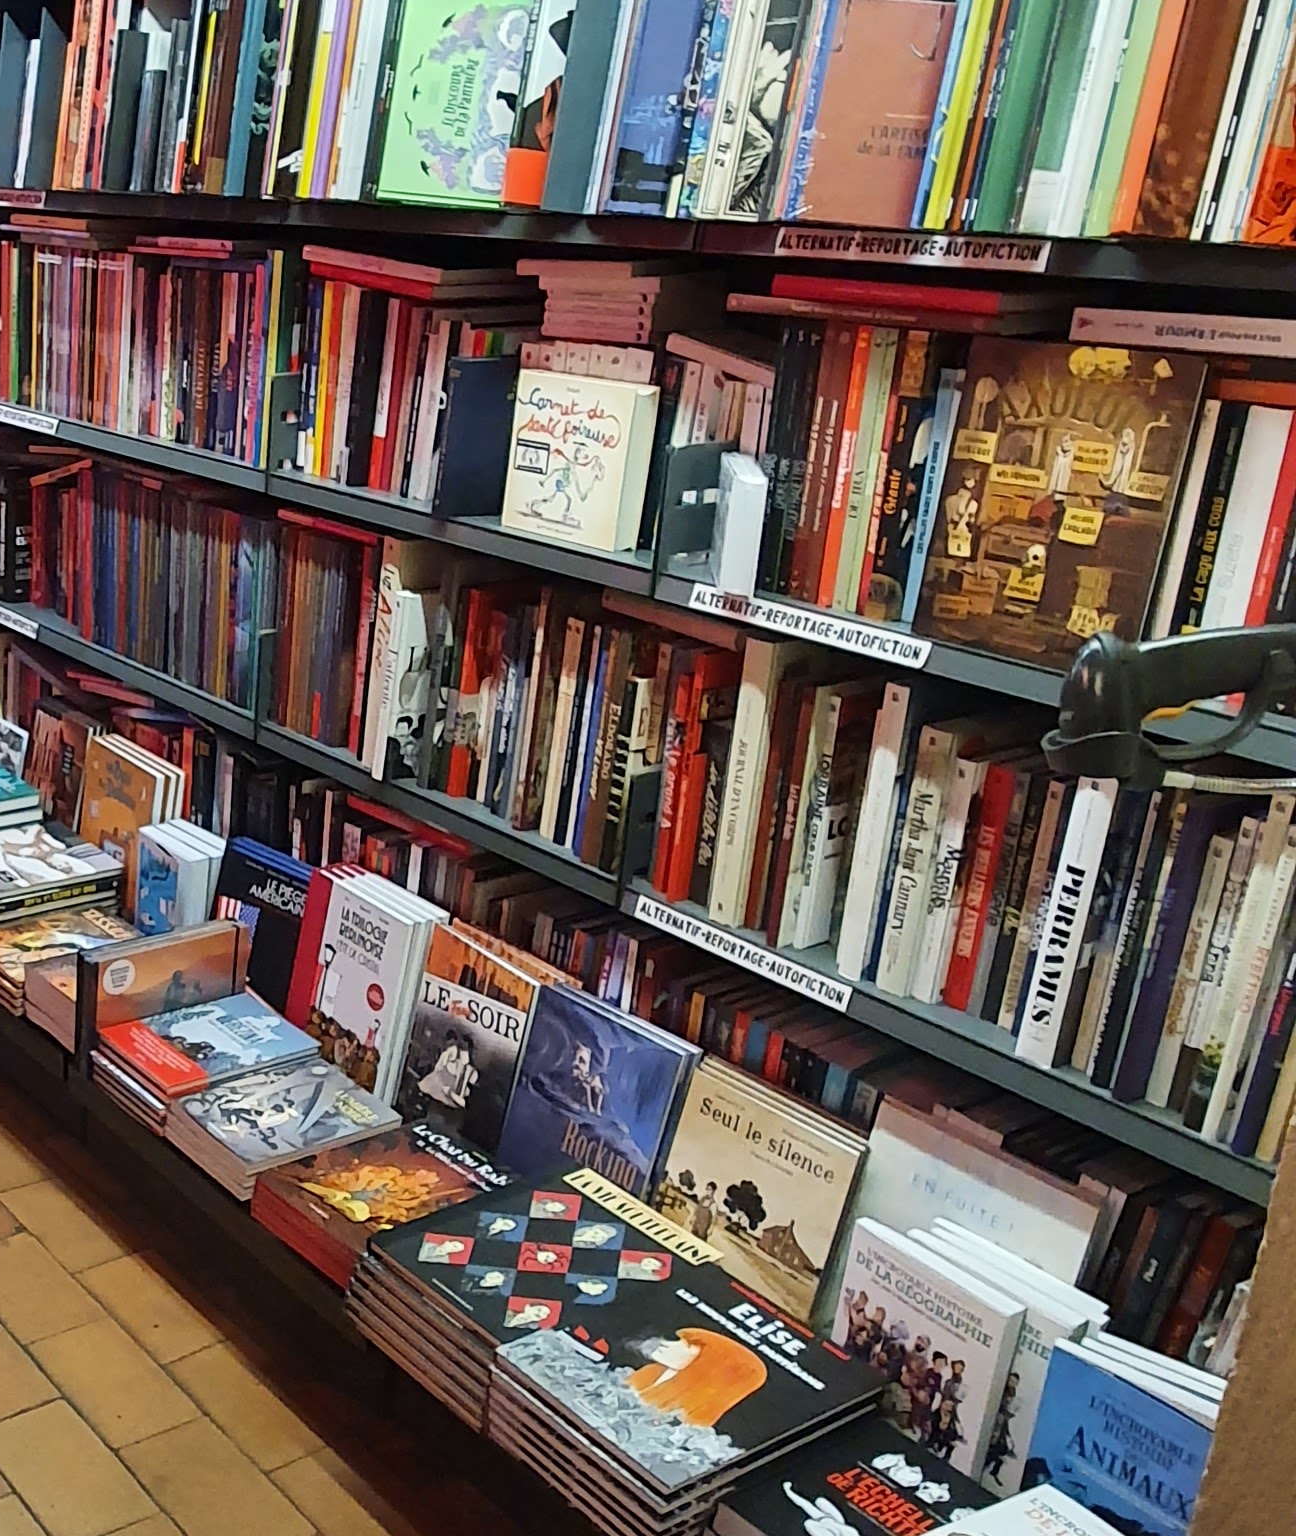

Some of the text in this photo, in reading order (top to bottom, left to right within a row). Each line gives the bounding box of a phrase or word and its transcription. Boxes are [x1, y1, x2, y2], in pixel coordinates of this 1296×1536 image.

[778, 232, 1043, 263] ALTERNATIF REPORTAGE AUTOFICTION
[519, 387, 579, 416] Carnet
[883, 467, 903, 516] Géante
[693, 590, 923, 664] ALTERNATIF REPORTAGE AUTOFICTION
[814, 752, 832, 822] LORRAINE
[889, 787, 935, 934] Martha Jane Cannary
[340, 905, 390, 947] LA TRILOGIE
[639, 901, 849, 1007] ALTERNATIF REPORTAGE AUTOFICTION
[1031, 863, 1087, 1033] PERRAMUS
[423, 980, 452, 1010] LE
[466, 1002, 521, 1043] SOIR
[699, 1096, 836, 1186] Seul le silence
[911, 1170, 1001, 1231] EN FUITE
[855, 1249, 876, 1277] DE
[875, 1260, 893, 1284] LA
[893, 1273, 995, 1350] GÉOGRAPHIE
[842, 1468, 935, 1532] L'ECHELL
[1065, 1425, 1196, 1522] ANIMAUX
[1023, 1507, 1054, 1531] DE
